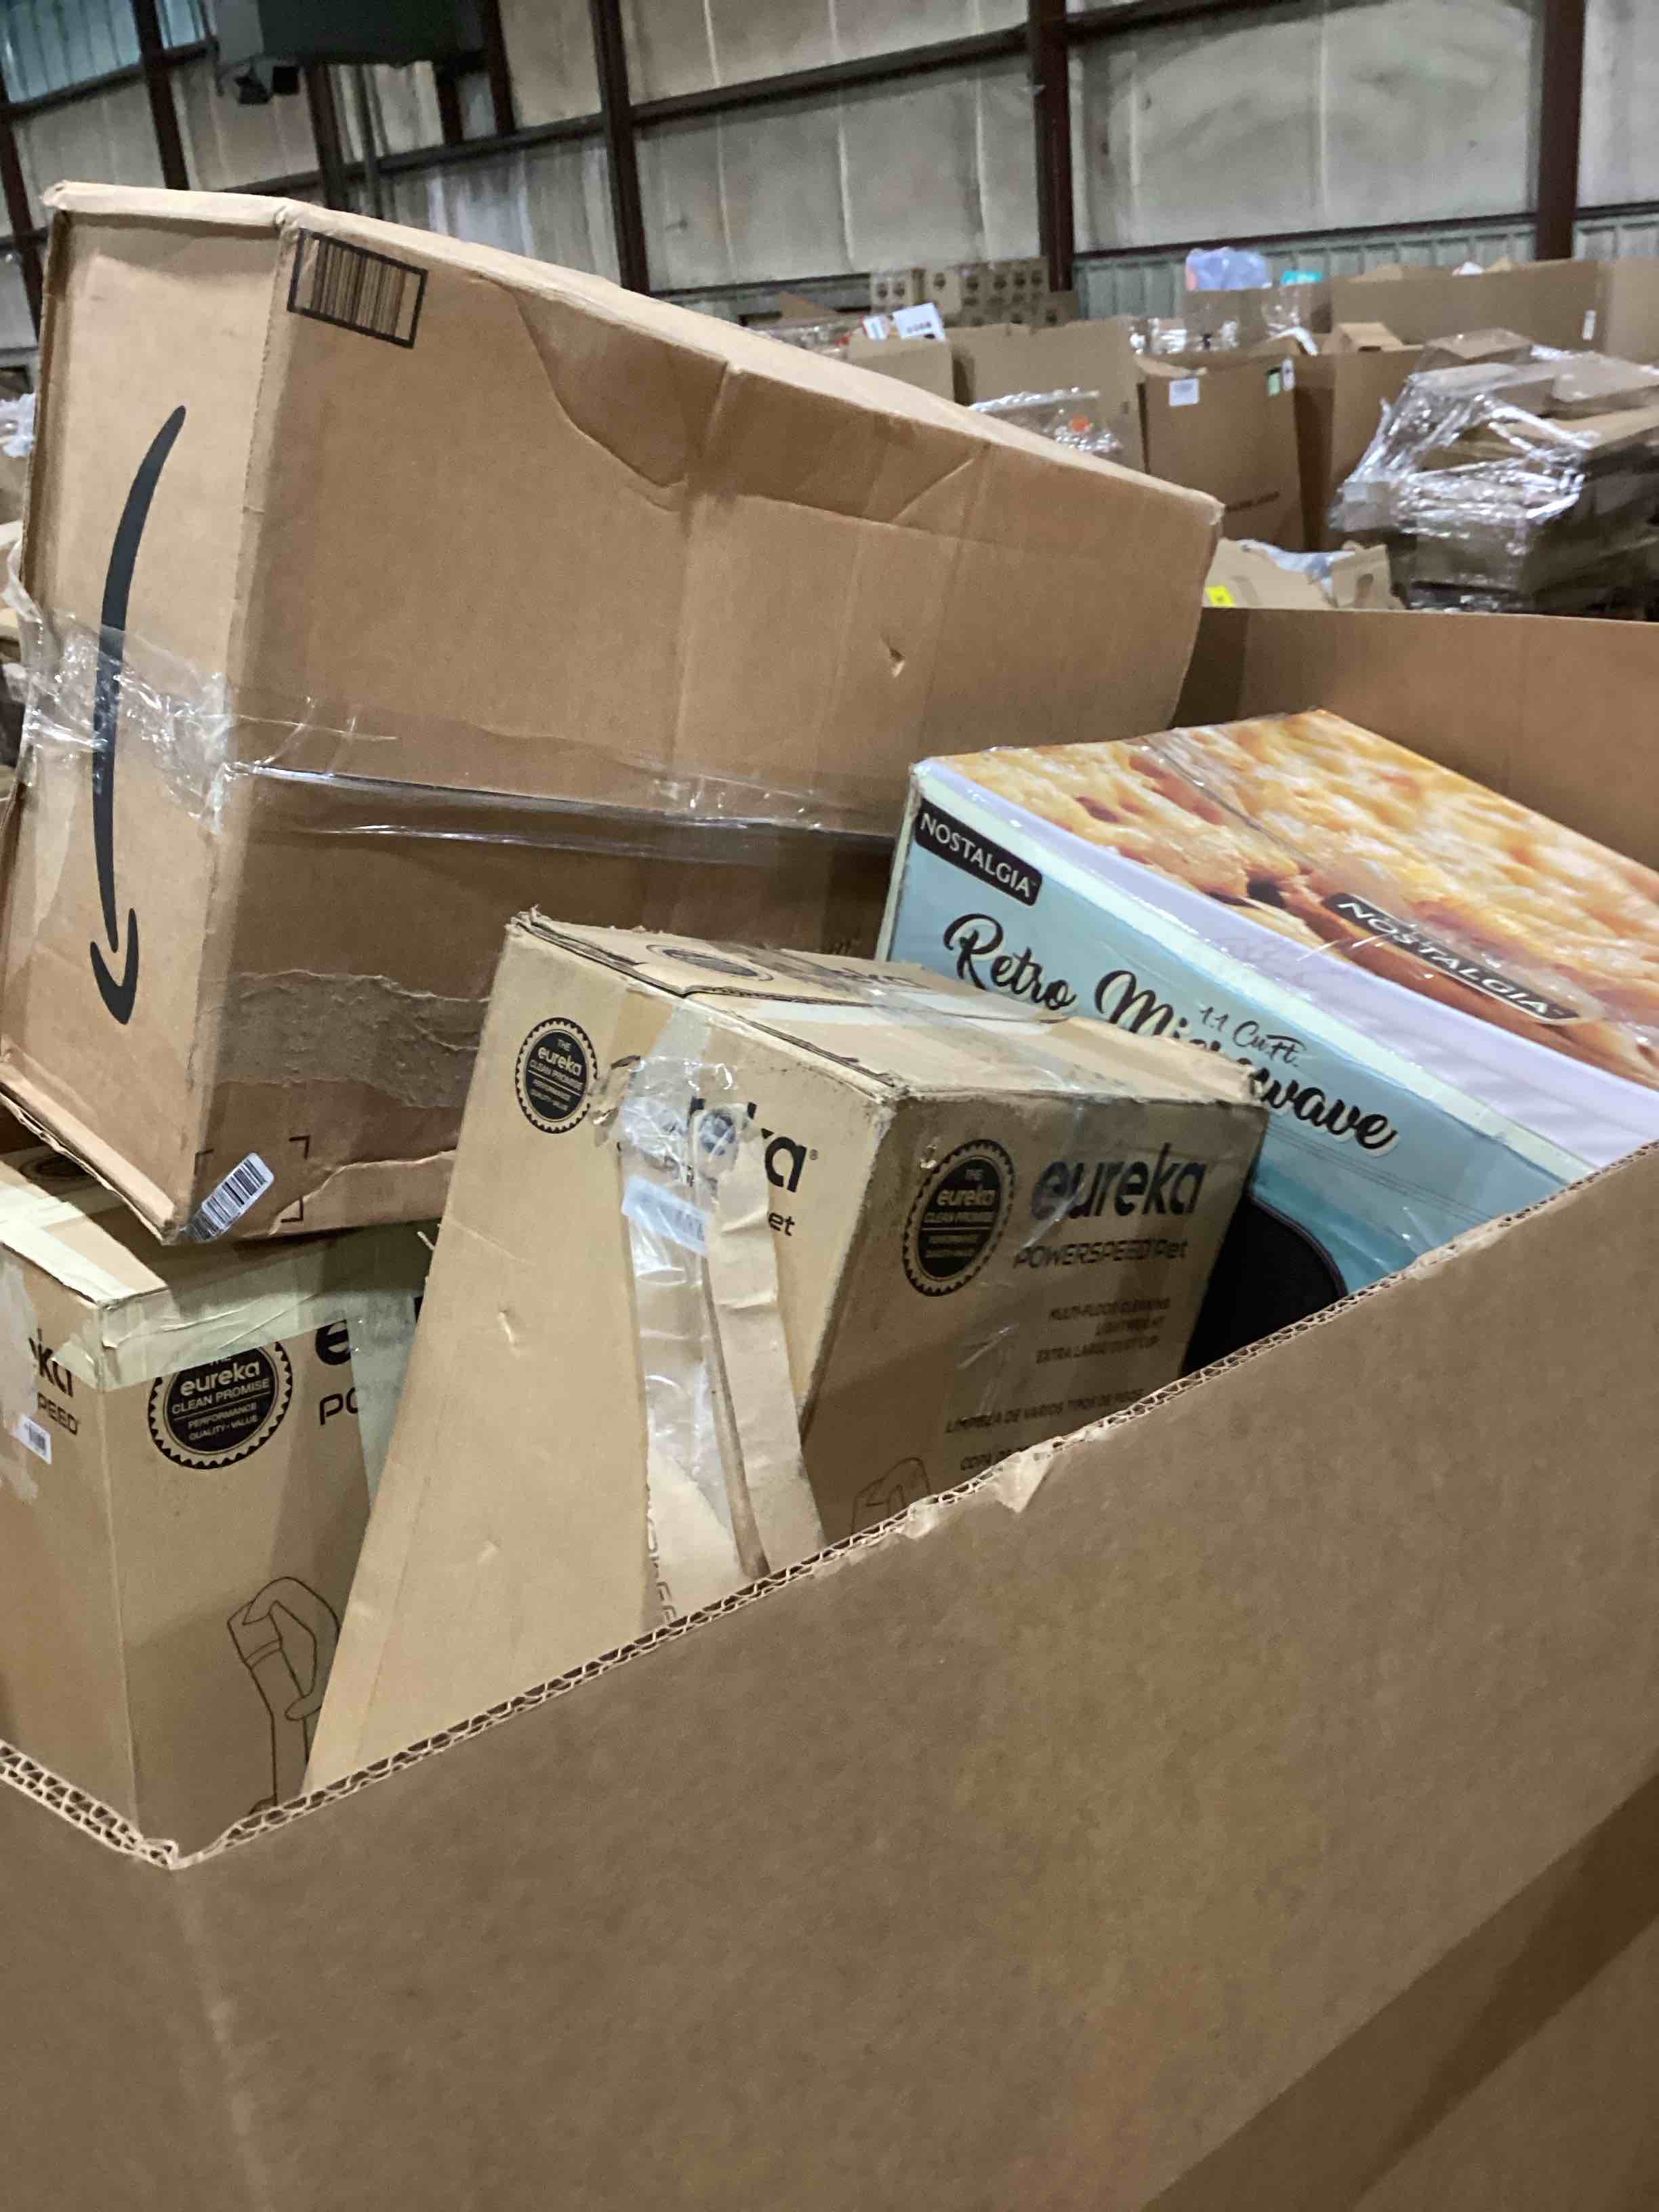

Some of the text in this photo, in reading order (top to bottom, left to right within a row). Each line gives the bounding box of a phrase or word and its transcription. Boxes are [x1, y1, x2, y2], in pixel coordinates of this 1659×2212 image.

[920, 813, 1031, 898] NOSTALGIA
[943, 913, 1077, 1011] Retro
[1337, 901, 1549, 1015] NOSTALGIA
[537, 1046, 582, 1077] eureka
[937, 1185, 998, 1206] eureka
[1030, 1141, 1206, 1221] eureka
[768, 1212, 796, 1237] et
[171, 1377, 270, 1414] CLEAN PROMISE
[180, 1360, 261, 1396] eureka
